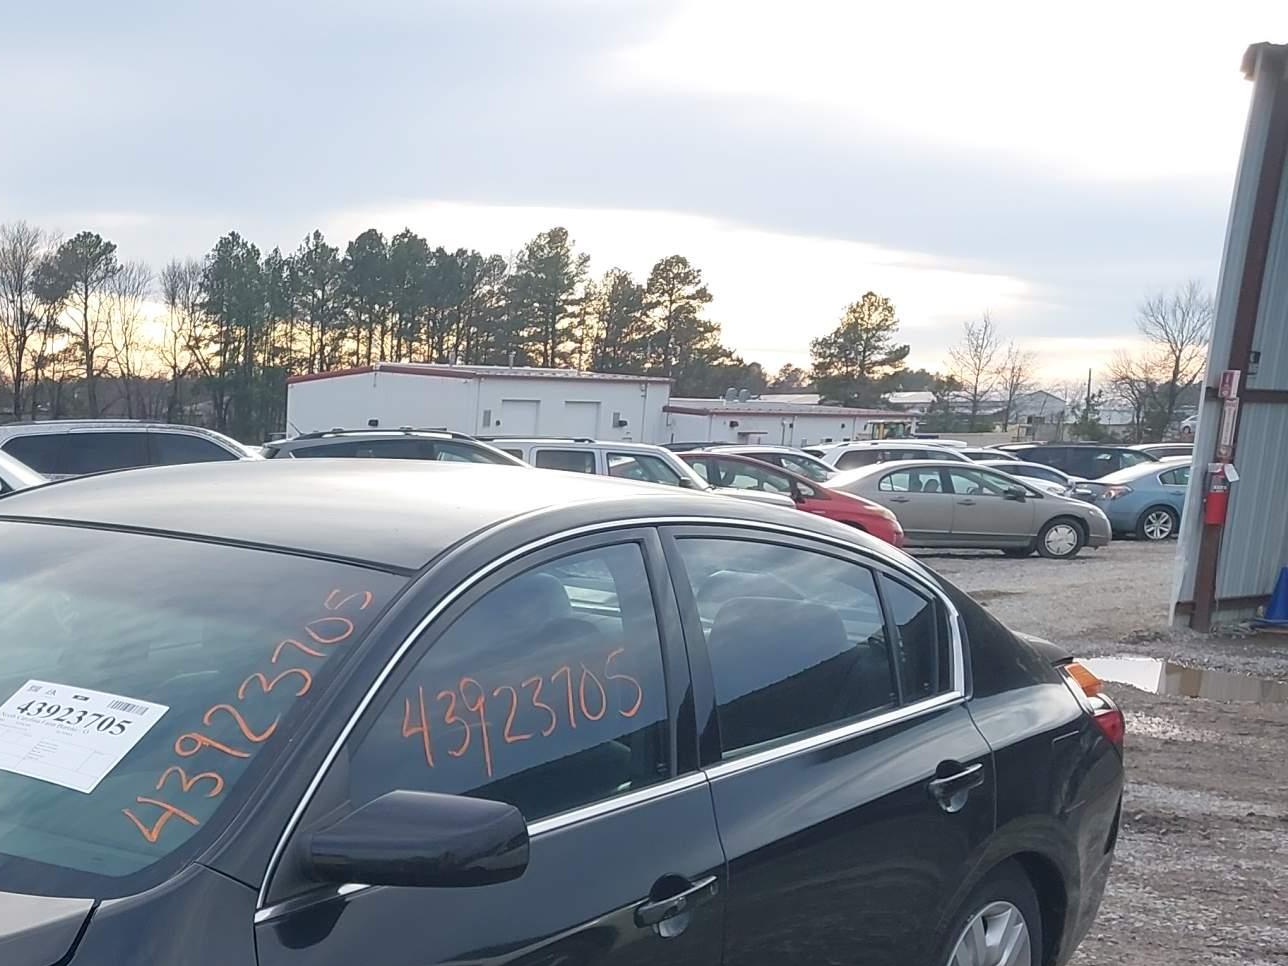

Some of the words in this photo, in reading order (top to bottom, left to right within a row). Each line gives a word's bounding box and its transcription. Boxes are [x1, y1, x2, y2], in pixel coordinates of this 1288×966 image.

[17, 700, 133, 736] 43923705
[122, 589, 373, 841] 43923705
[402, 648, 643, 777] 43923705
